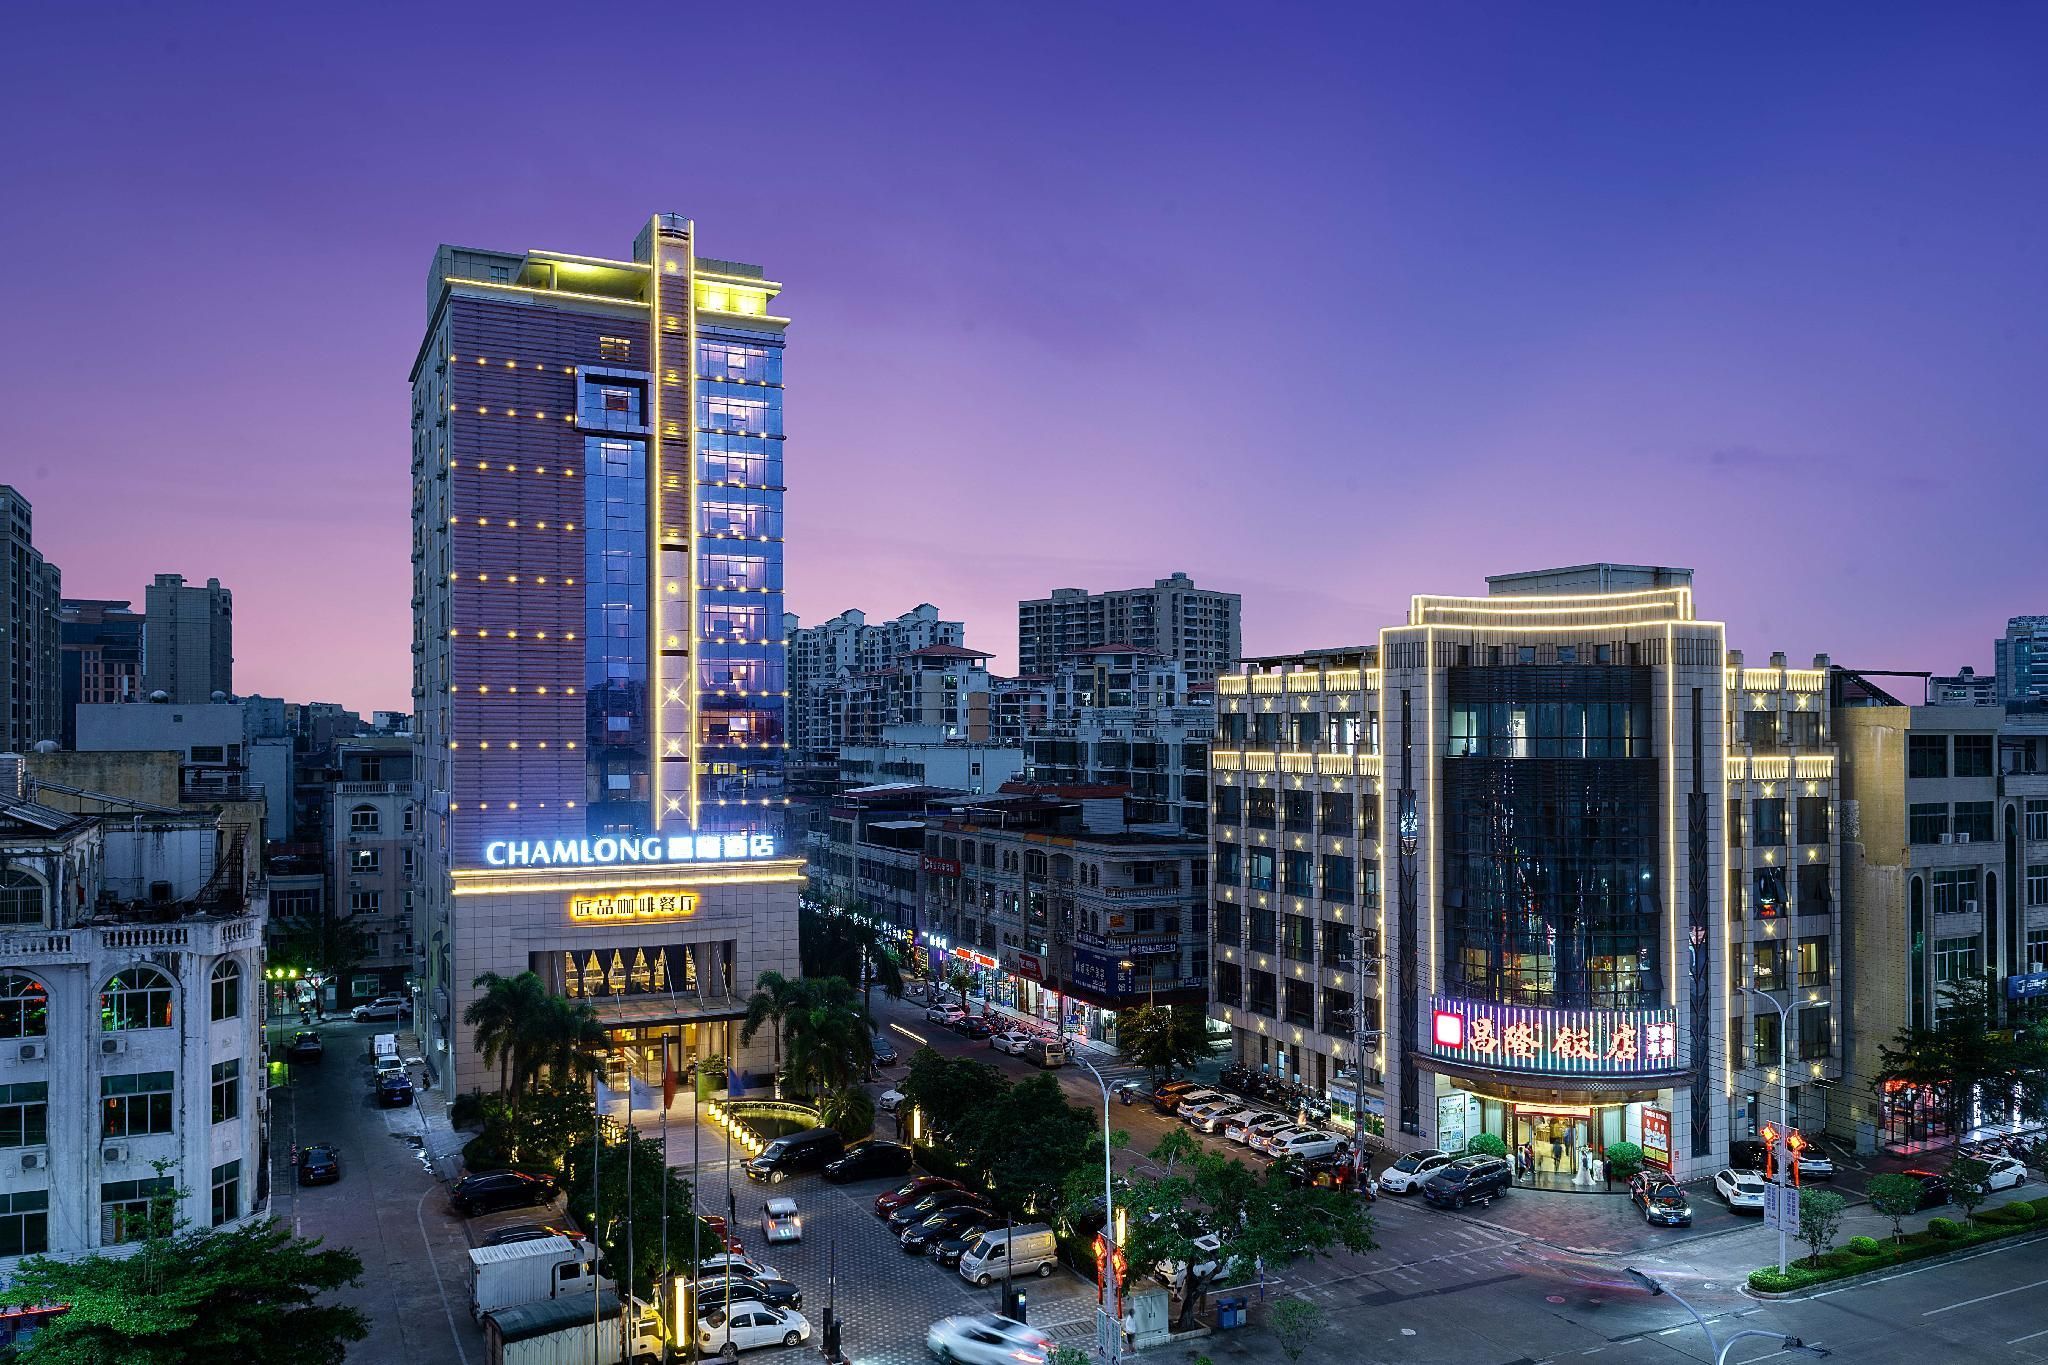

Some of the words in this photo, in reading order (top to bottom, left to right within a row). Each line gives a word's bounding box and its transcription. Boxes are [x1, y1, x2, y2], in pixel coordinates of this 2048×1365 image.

[485, 836, 662, 865] CHAMLONG
[576, 896, 696, 917] 匠品咖啡餐厅
